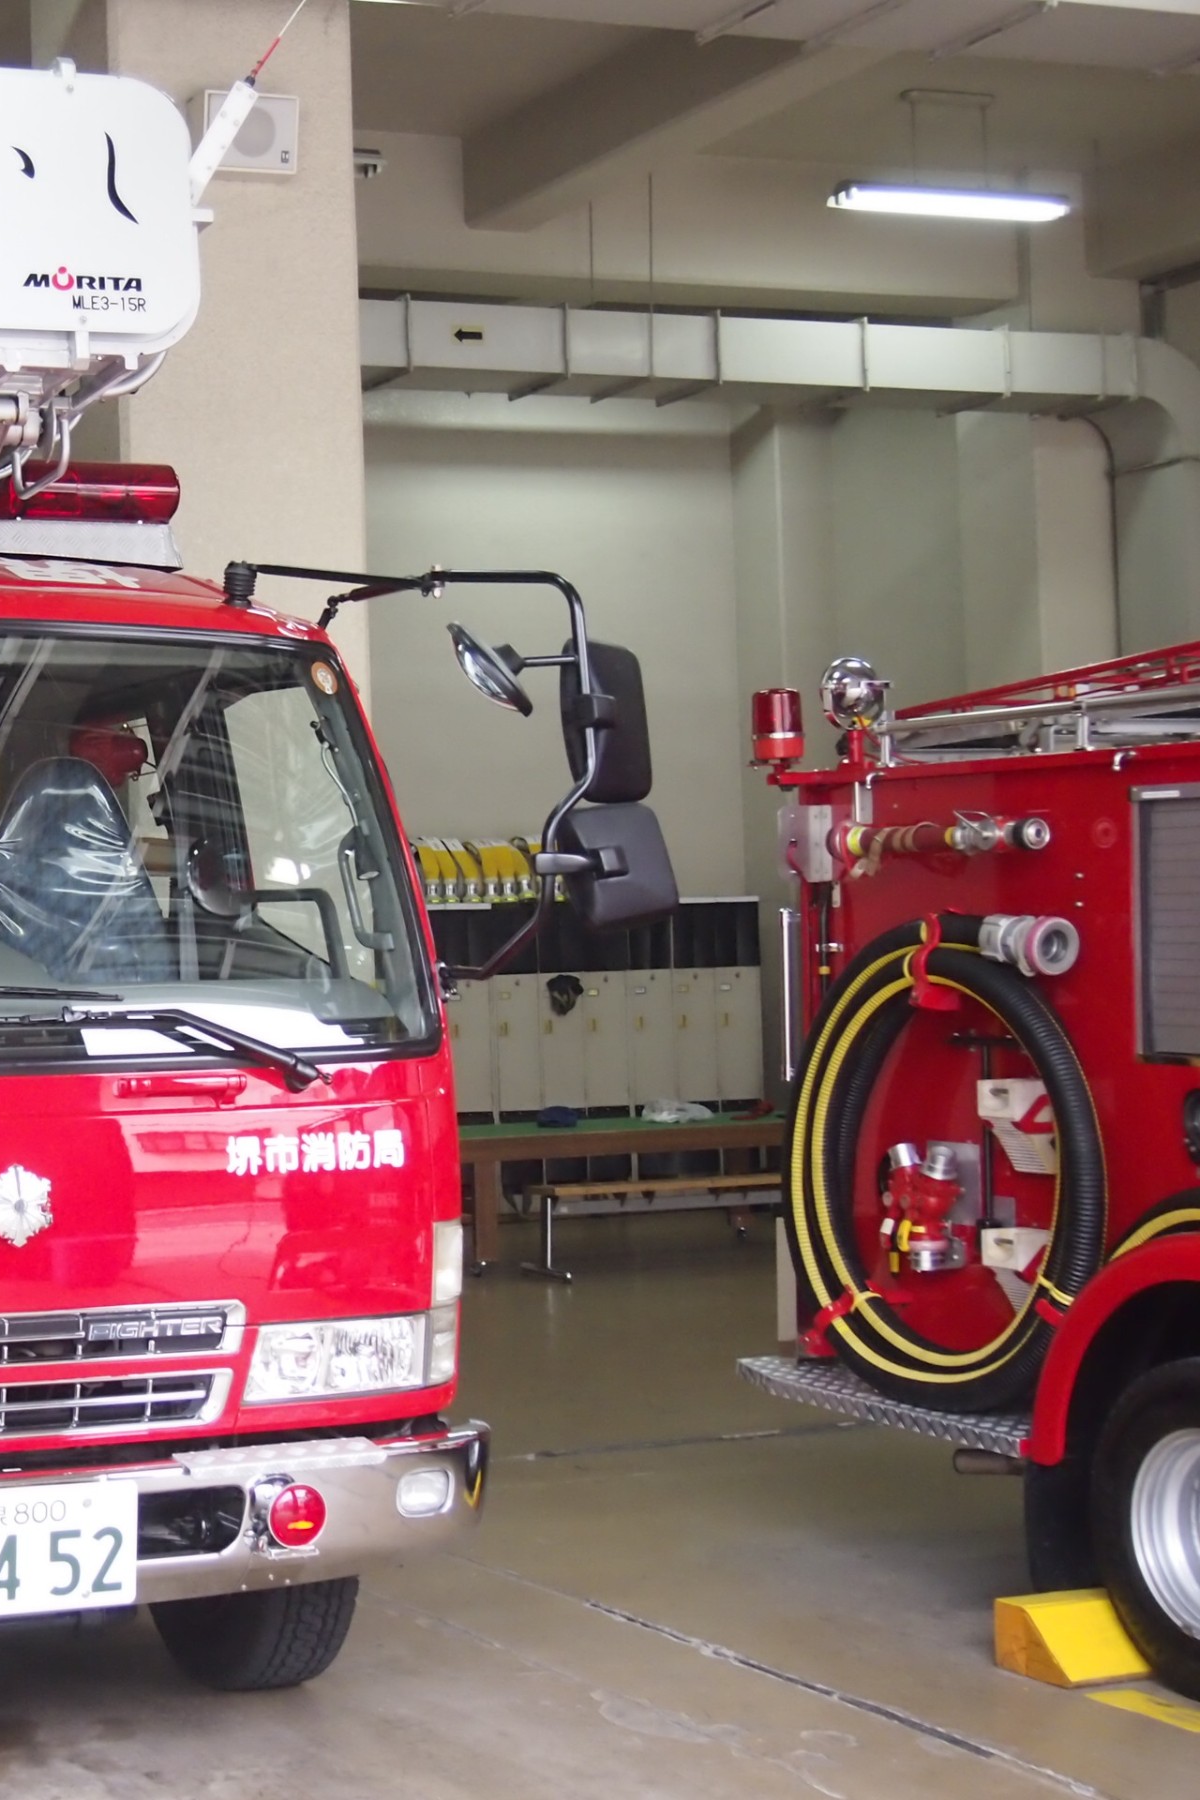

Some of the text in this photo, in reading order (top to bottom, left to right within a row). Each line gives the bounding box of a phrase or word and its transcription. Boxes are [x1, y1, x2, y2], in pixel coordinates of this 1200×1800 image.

[23, 266, 143, 292] MORITA
[72, 295, 147, 312] MLE3-15R
[226, 1130, 405, 1176] 堺市消防局
[88, 1316, 222, 1341] FIGHTER
